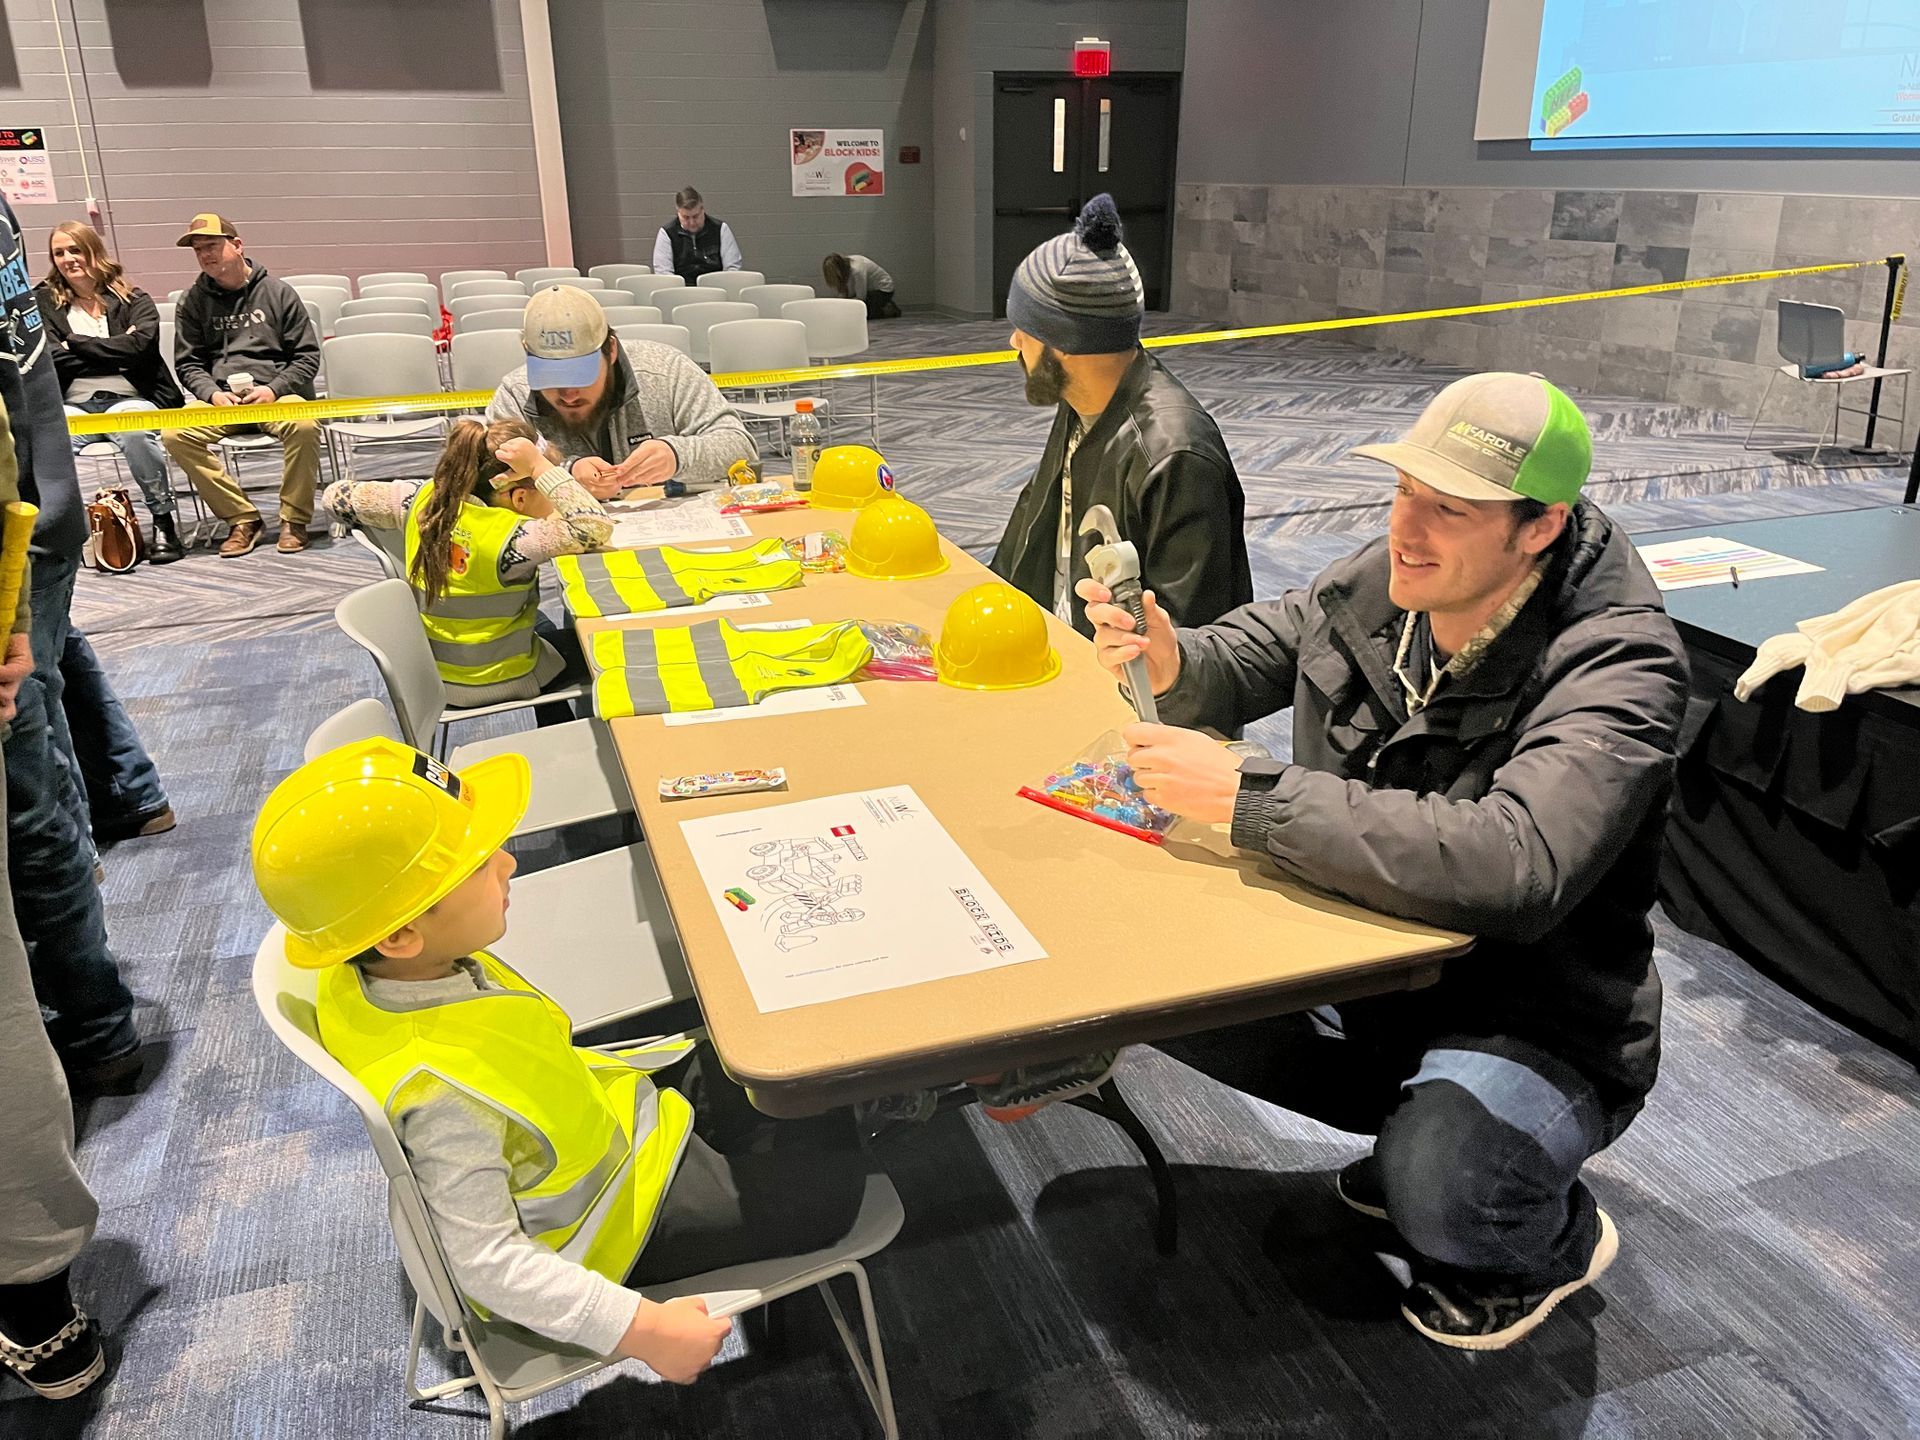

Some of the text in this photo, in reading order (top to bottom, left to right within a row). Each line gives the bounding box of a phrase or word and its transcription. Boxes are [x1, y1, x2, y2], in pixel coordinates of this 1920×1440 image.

[824, 148, 855, 157] BLOCK
[425, 757, 450, 789] CAT
[955, 887, 990, 921] BLOCK
[983, 923, 1015, 952] KIDS
